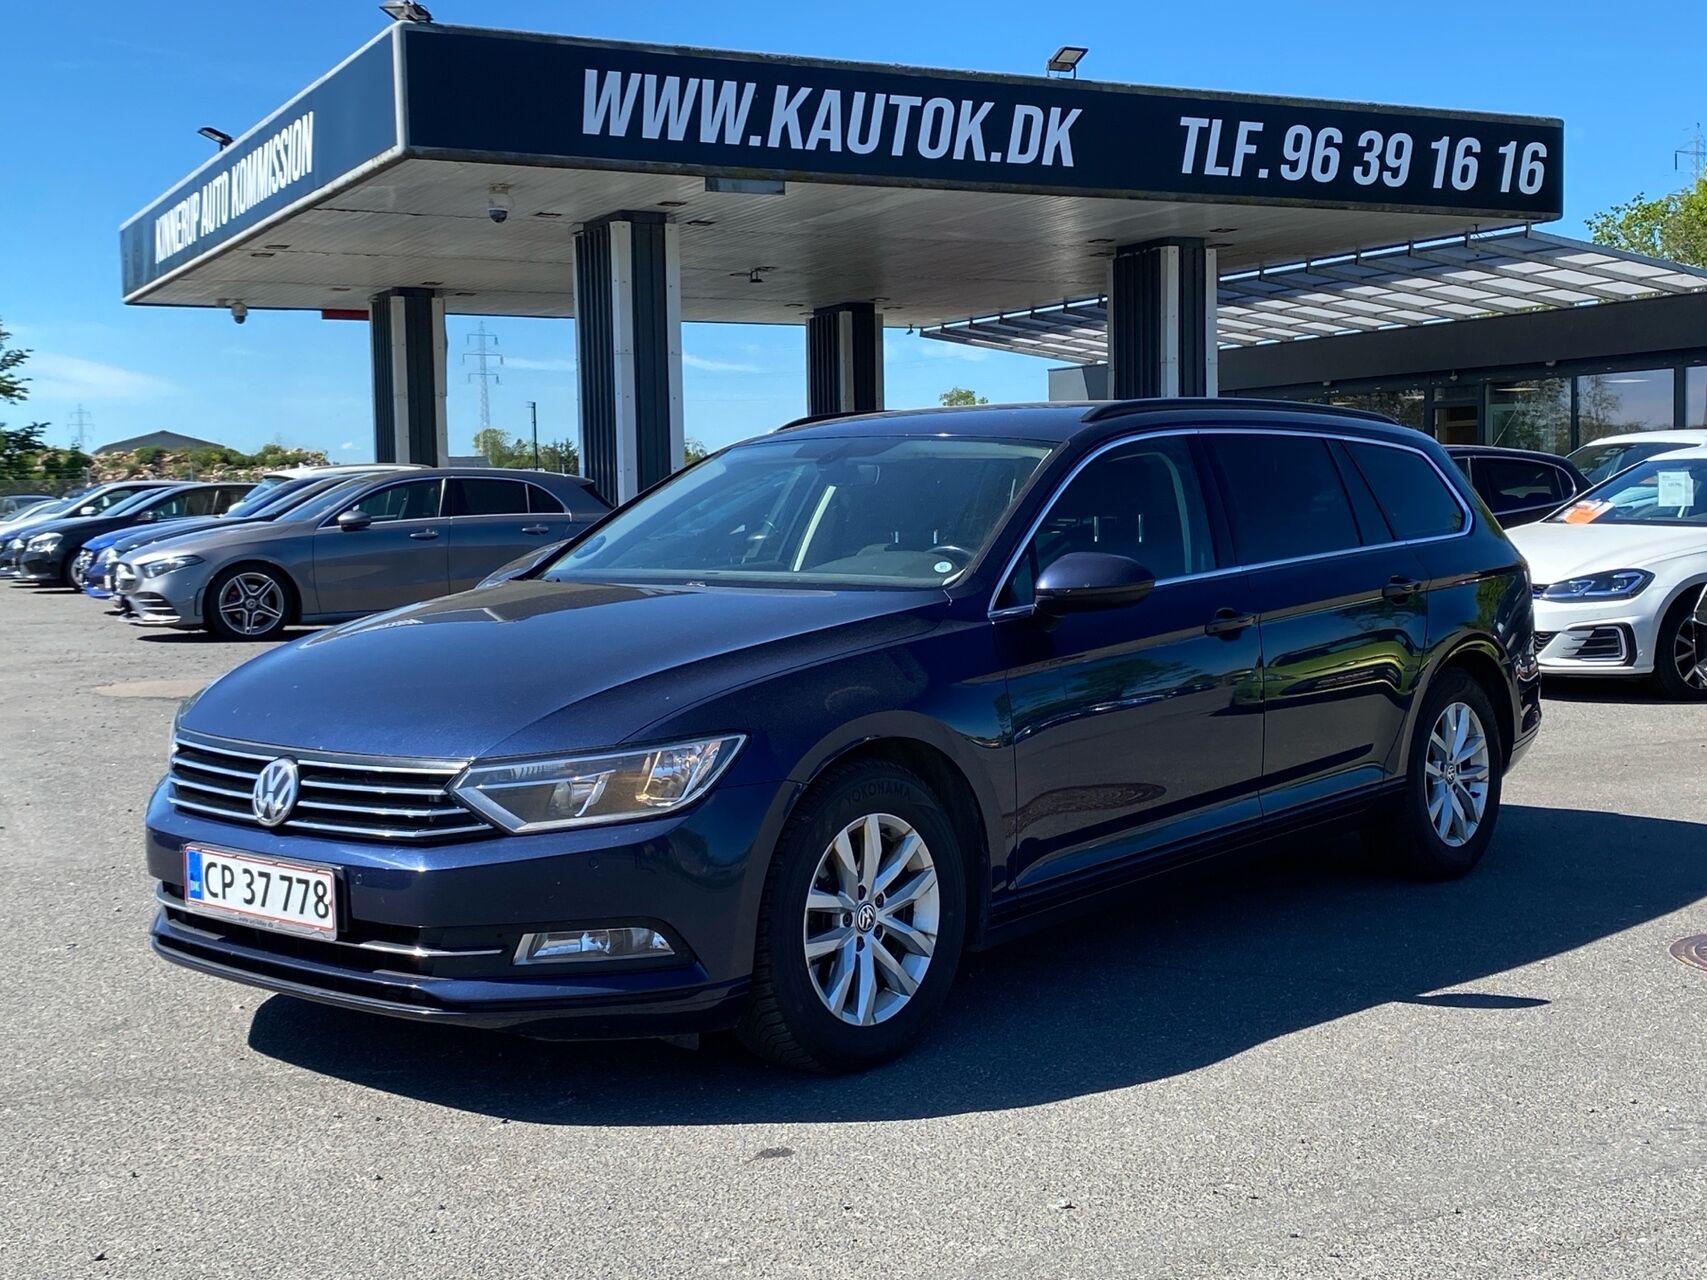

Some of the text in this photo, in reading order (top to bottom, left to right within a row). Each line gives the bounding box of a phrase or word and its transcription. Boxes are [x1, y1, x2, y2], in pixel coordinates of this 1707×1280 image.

[582, 68, 1083, 168] WWW.KAUTOK.DK
[1180, 116, 1548, 195] TLF. 96 39 16 16
[200, 171, 229, 238] AUTO
[231, 111, 314, 219] KOMMISSION
[204, 861, 330, 919] CP 37 778
